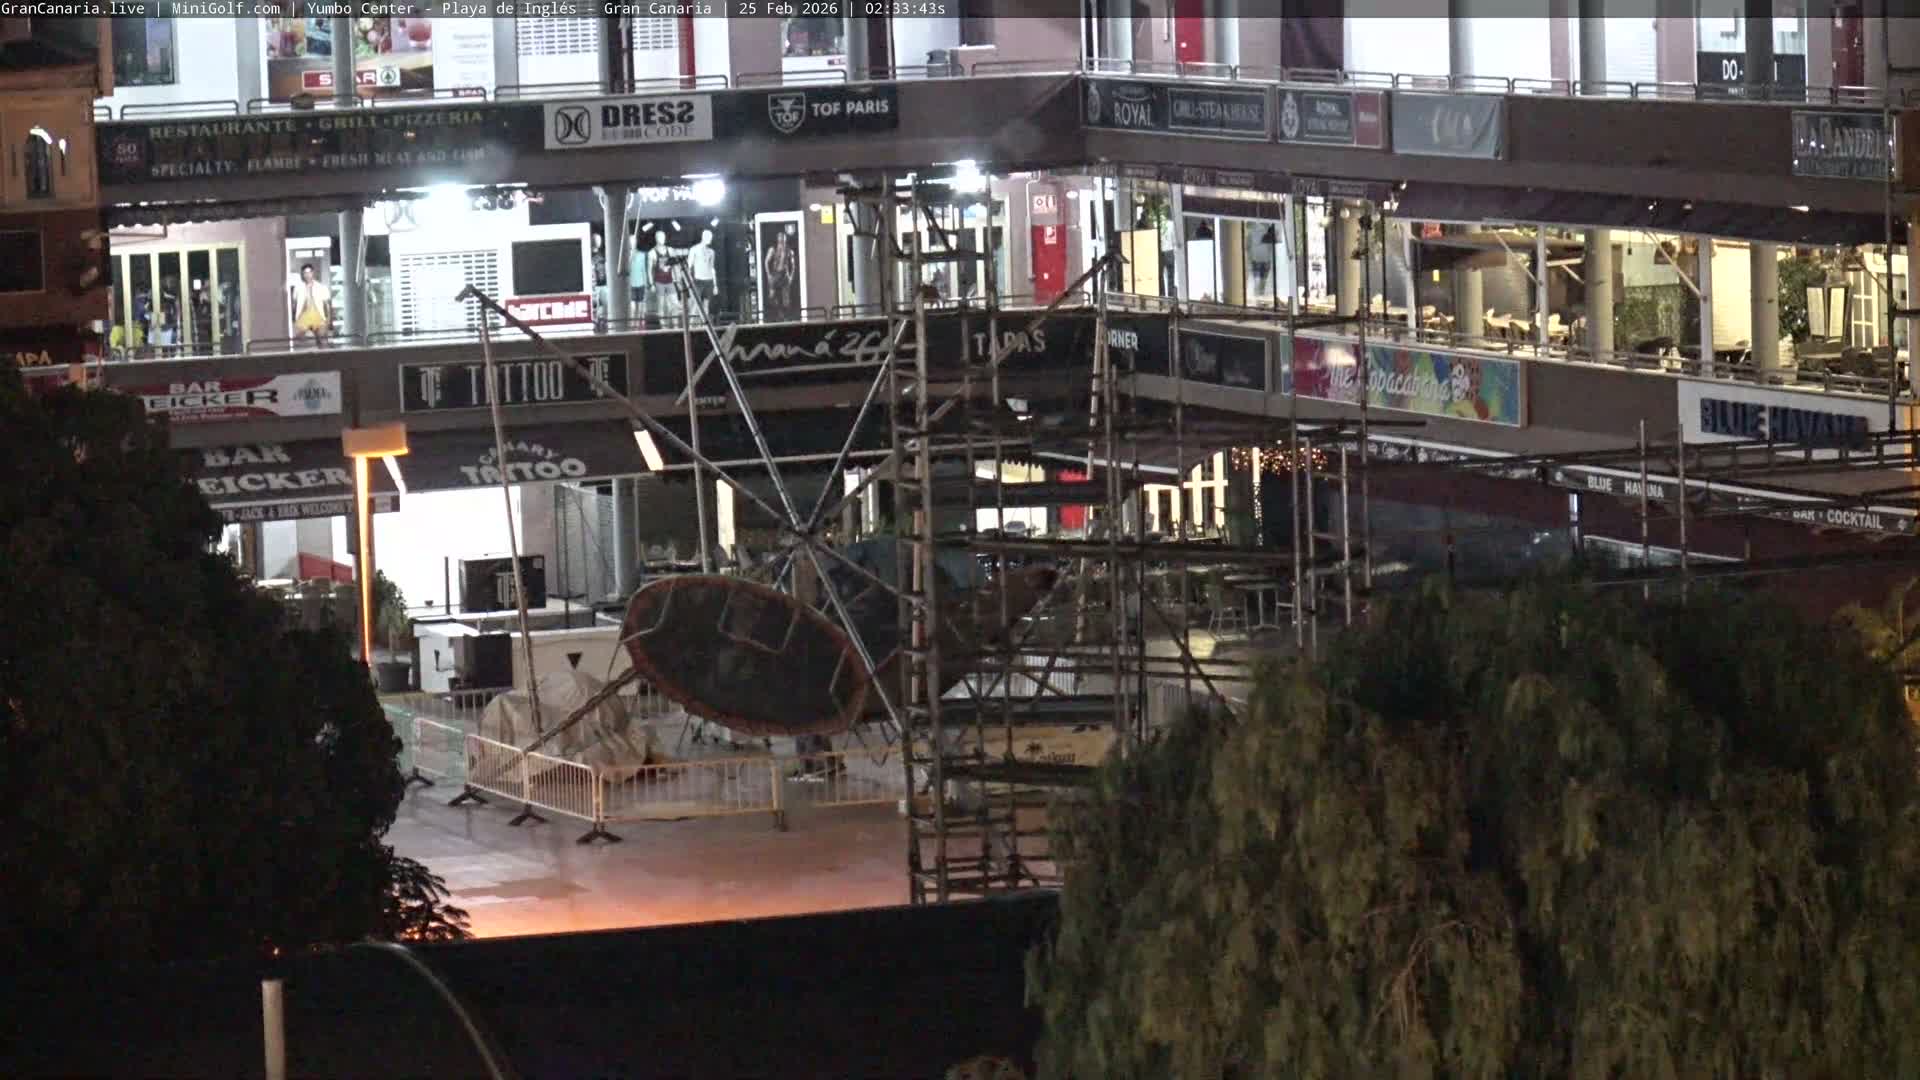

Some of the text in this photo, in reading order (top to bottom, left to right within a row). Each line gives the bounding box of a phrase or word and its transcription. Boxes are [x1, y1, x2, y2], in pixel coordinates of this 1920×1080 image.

[318, 73, 376, 86] SR
[776, 112, 799, 124] TOF
[811, 98, 889, 117] TOF PARIS
[1114, 102, 1152, 127] ROYAL
[150, 119, 297, 138] RESTAURANTE
[393, 110, 483, 127] PIZZERIA
[973, 328, 1138, 356] TAPAS RNER
[169, 381, 221, 395] BAR
[468, 360, 564, 405] TATTOO
[150, 389, 279, 410] EICKER
[1701, 397, 1766, 441] BLUE
[203, 445, 291, 468] BAR
[196, 467, 352, 496] EICKER
[460, 457, 587, 485] TATTOO
[1587, 475, 1613, 491] BLUE
[1827, 509, 1883, 529] COCKTAIL
